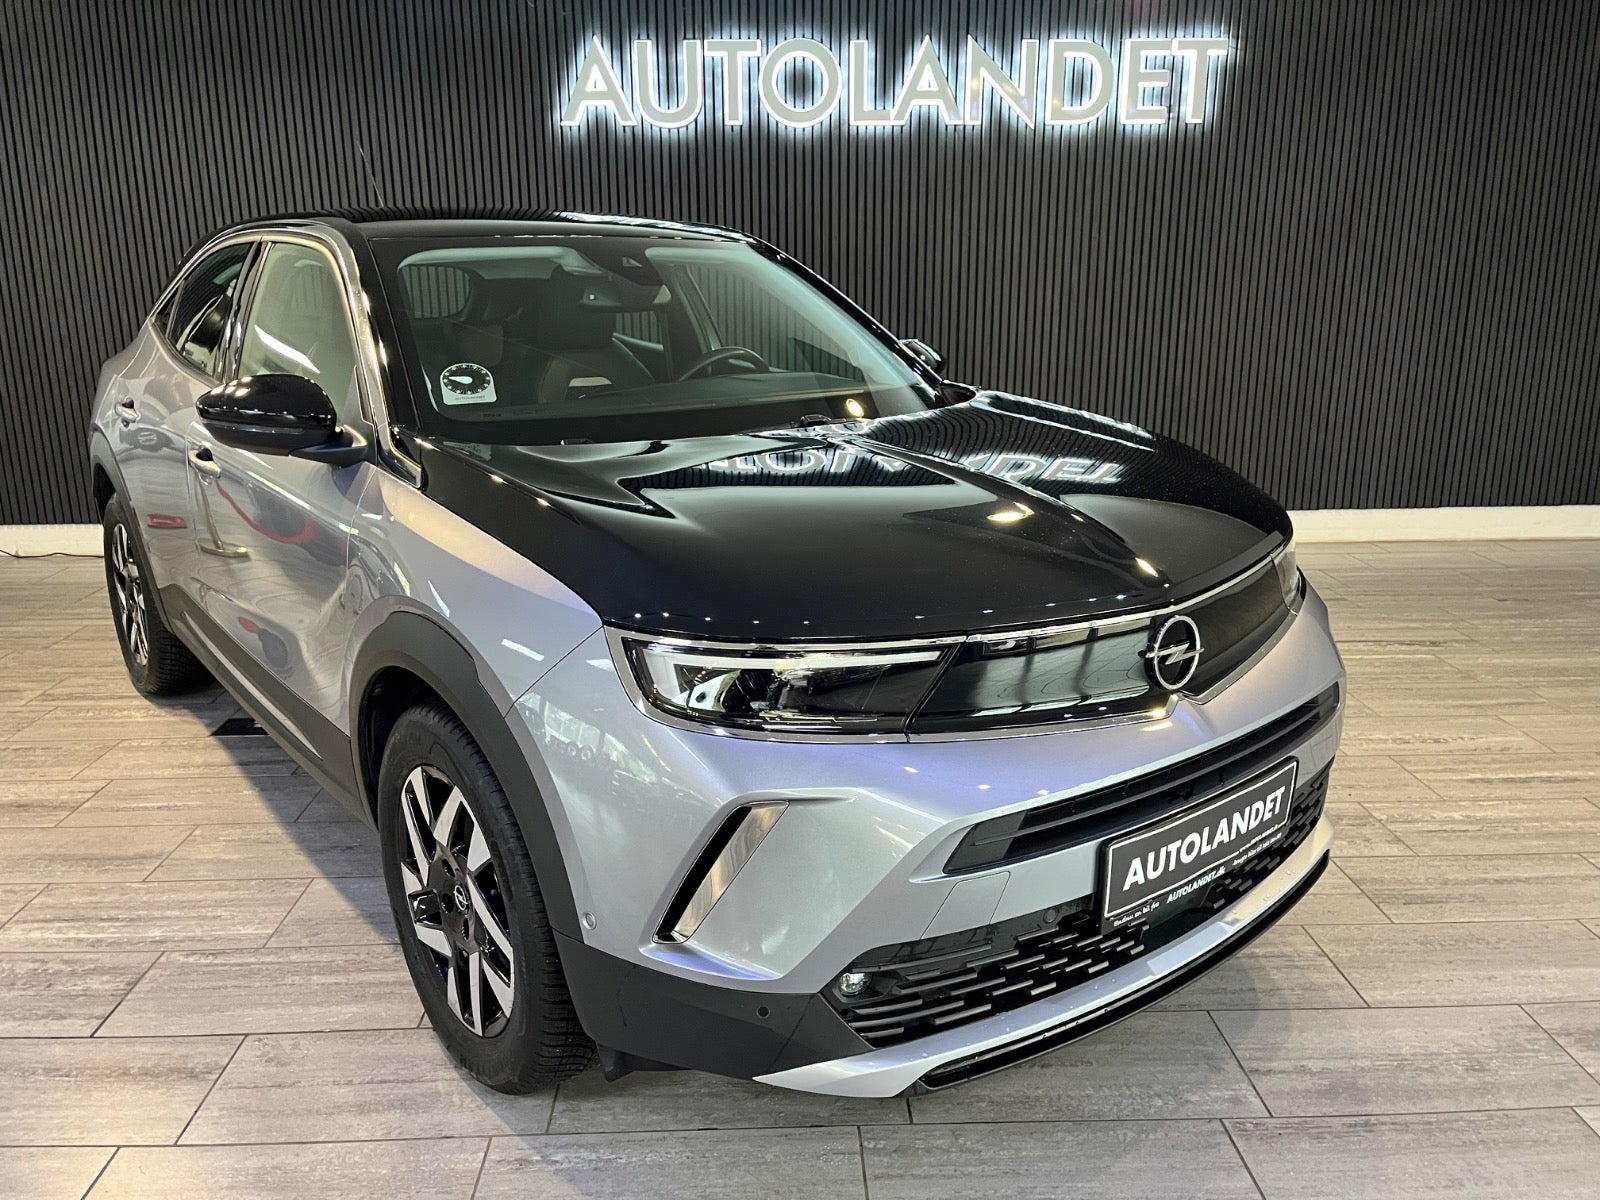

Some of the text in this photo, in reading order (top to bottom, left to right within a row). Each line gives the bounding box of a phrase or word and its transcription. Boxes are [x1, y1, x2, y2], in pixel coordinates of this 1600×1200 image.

[561, 34, 1228, 129] AUTOLANDET
[1122, 785, 1286, 892] AUTOLANDET
[1166, 865, 1226, 904] AUTOLANDET.dk
